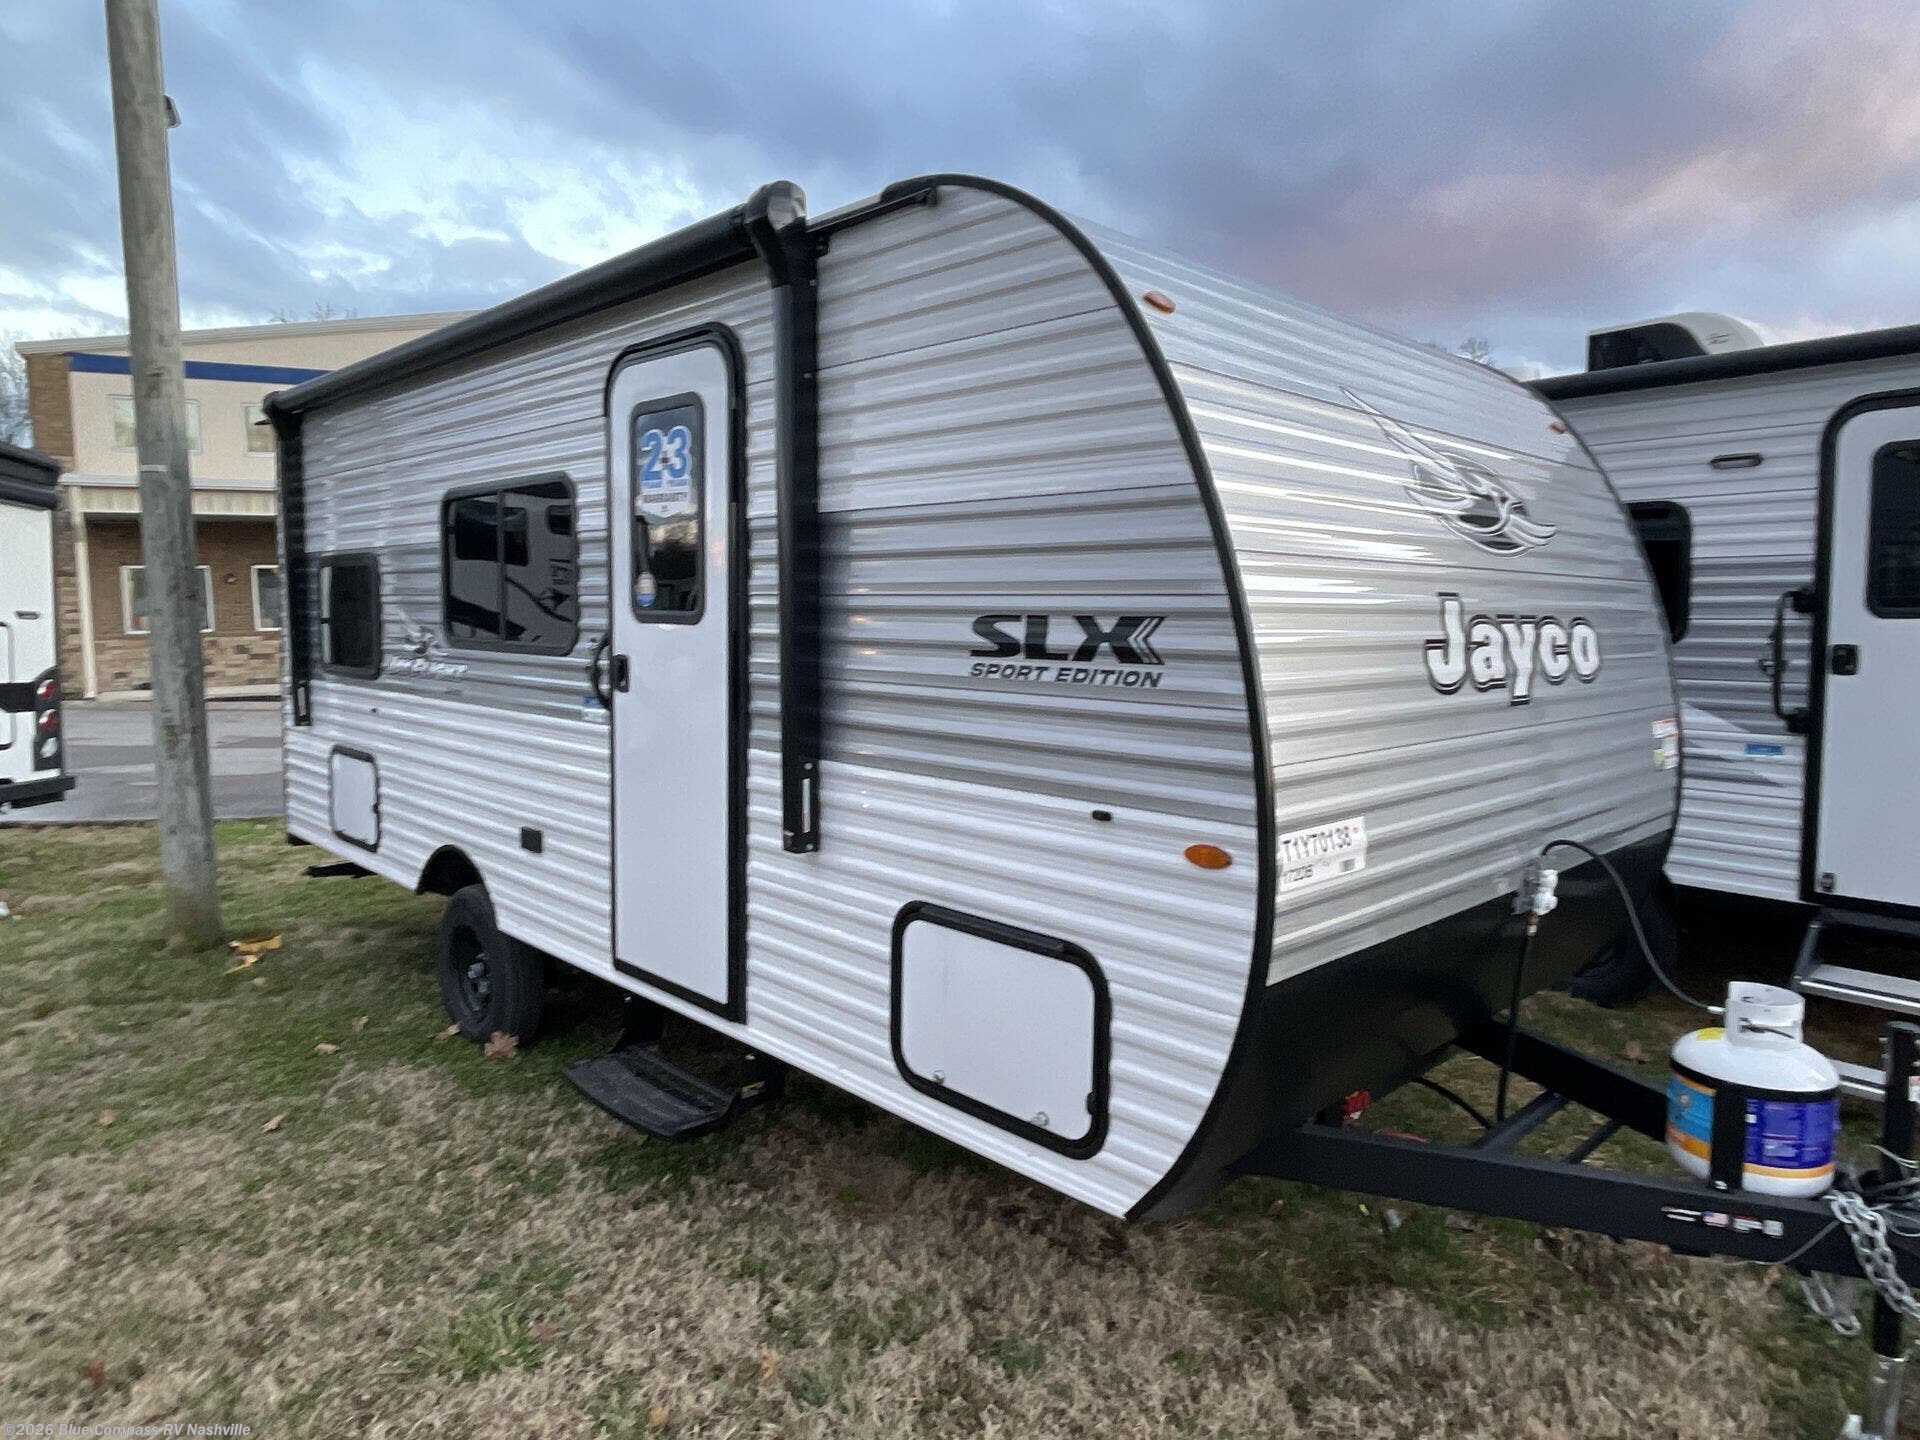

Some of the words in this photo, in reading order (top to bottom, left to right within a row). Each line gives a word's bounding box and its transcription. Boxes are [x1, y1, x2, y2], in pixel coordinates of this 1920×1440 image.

[969, 614, 1168, 665] SLX
[1424, 591, 1600, 706] Jayco
[970, 662, 1049, 681] SPORT
[1053, 667, 1164, 688] EDITION
